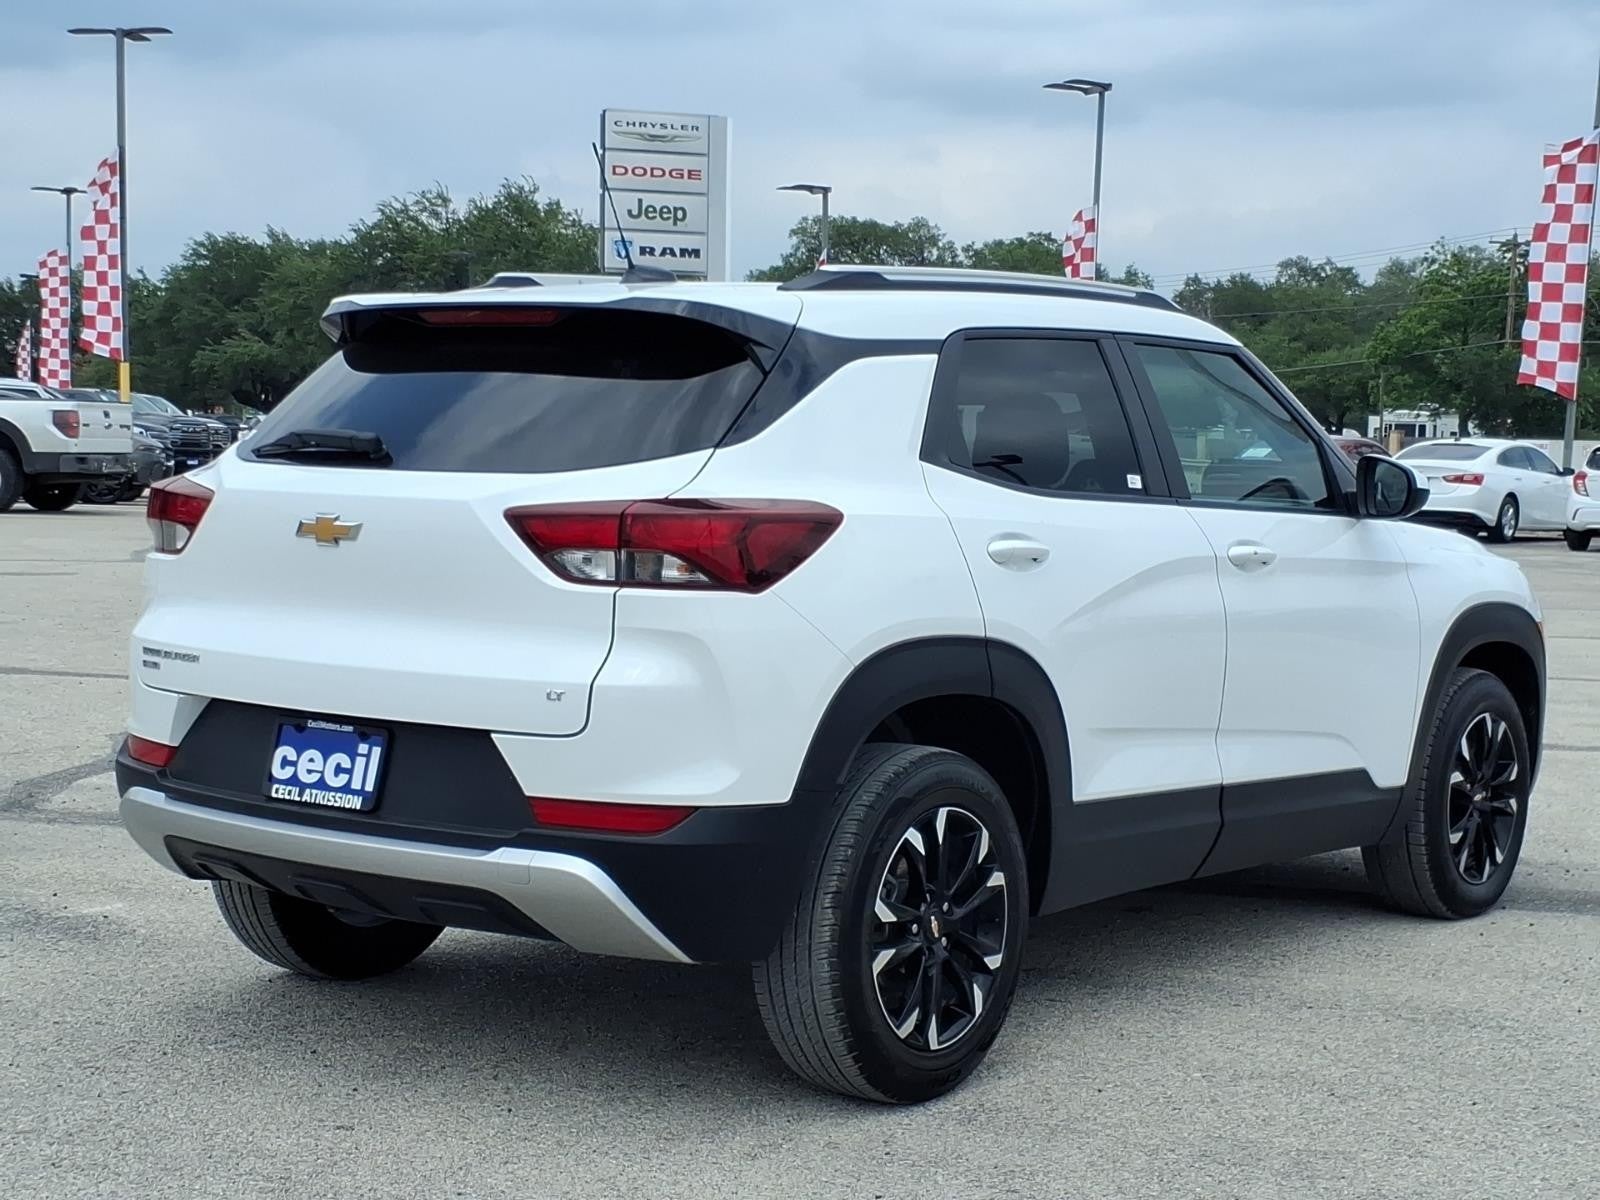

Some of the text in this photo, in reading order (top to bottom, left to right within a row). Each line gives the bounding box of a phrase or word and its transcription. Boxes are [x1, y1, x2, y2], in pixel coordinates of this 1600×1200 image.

[614, 120, 700, 132] CHRYSLER
[612, 165, 702, 181] DODGE
[627, 198, 688, 227] Jeep
[639, 245, 701, 259] RAM
[271, 743, 381, 792] cecil
[271, 784, 363, 810] CECIL ATKISSION
